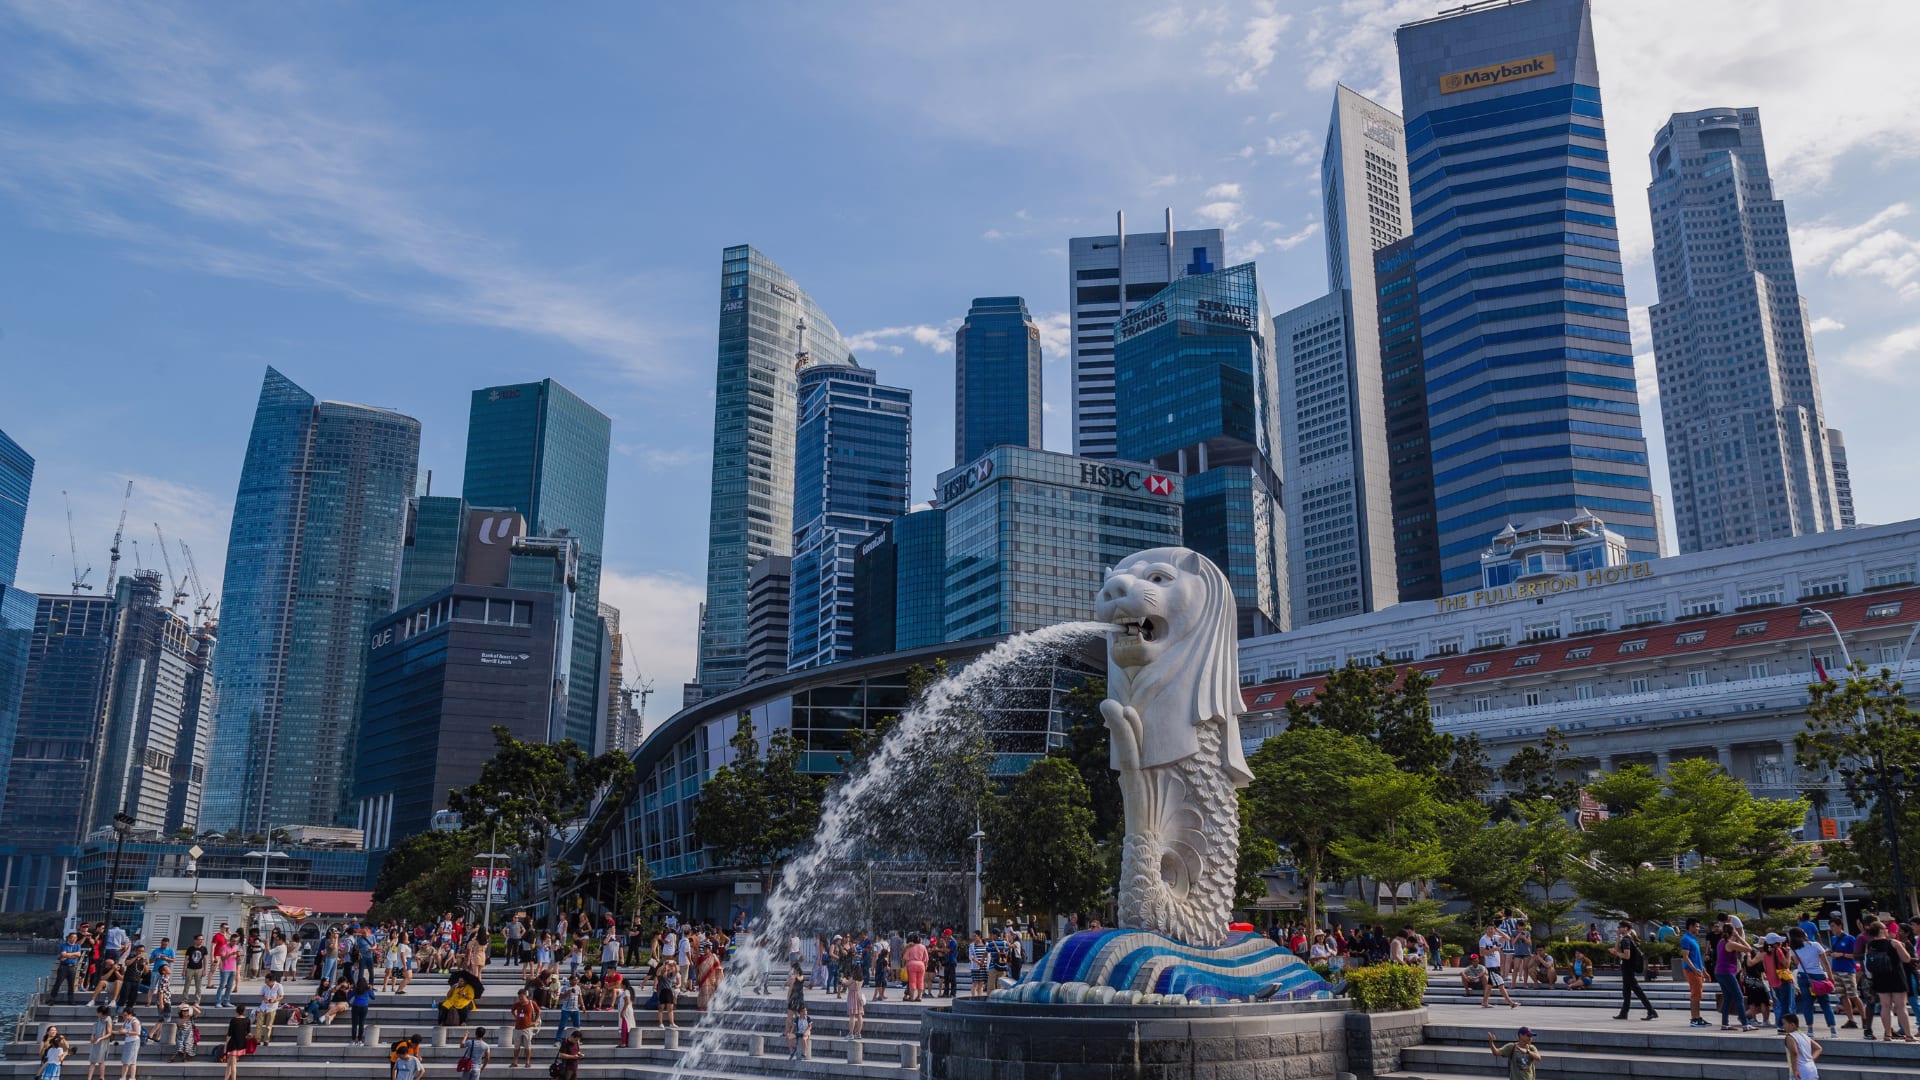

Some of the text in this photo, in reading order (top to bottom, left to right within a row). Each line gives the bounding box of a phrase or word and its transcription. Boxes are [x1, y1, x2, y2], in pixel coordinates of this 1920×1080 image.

[1464, 59, 1545, 86] Maybank
[724, 301, 744, 311] ANZ
[1121, 301, 1166, 328] STRAITS
[1195, 311, 1252, 328] TRADING
[1197, 299, 1252, 317] STRAITS
[1121, 312, 1168, 338] TRADING
[943, 468, 977, 504] HSBC
[1080, 462, 1142, 492] HSBC
[1436, 562, 1654, 612] THE FULLERTON HOTEL
